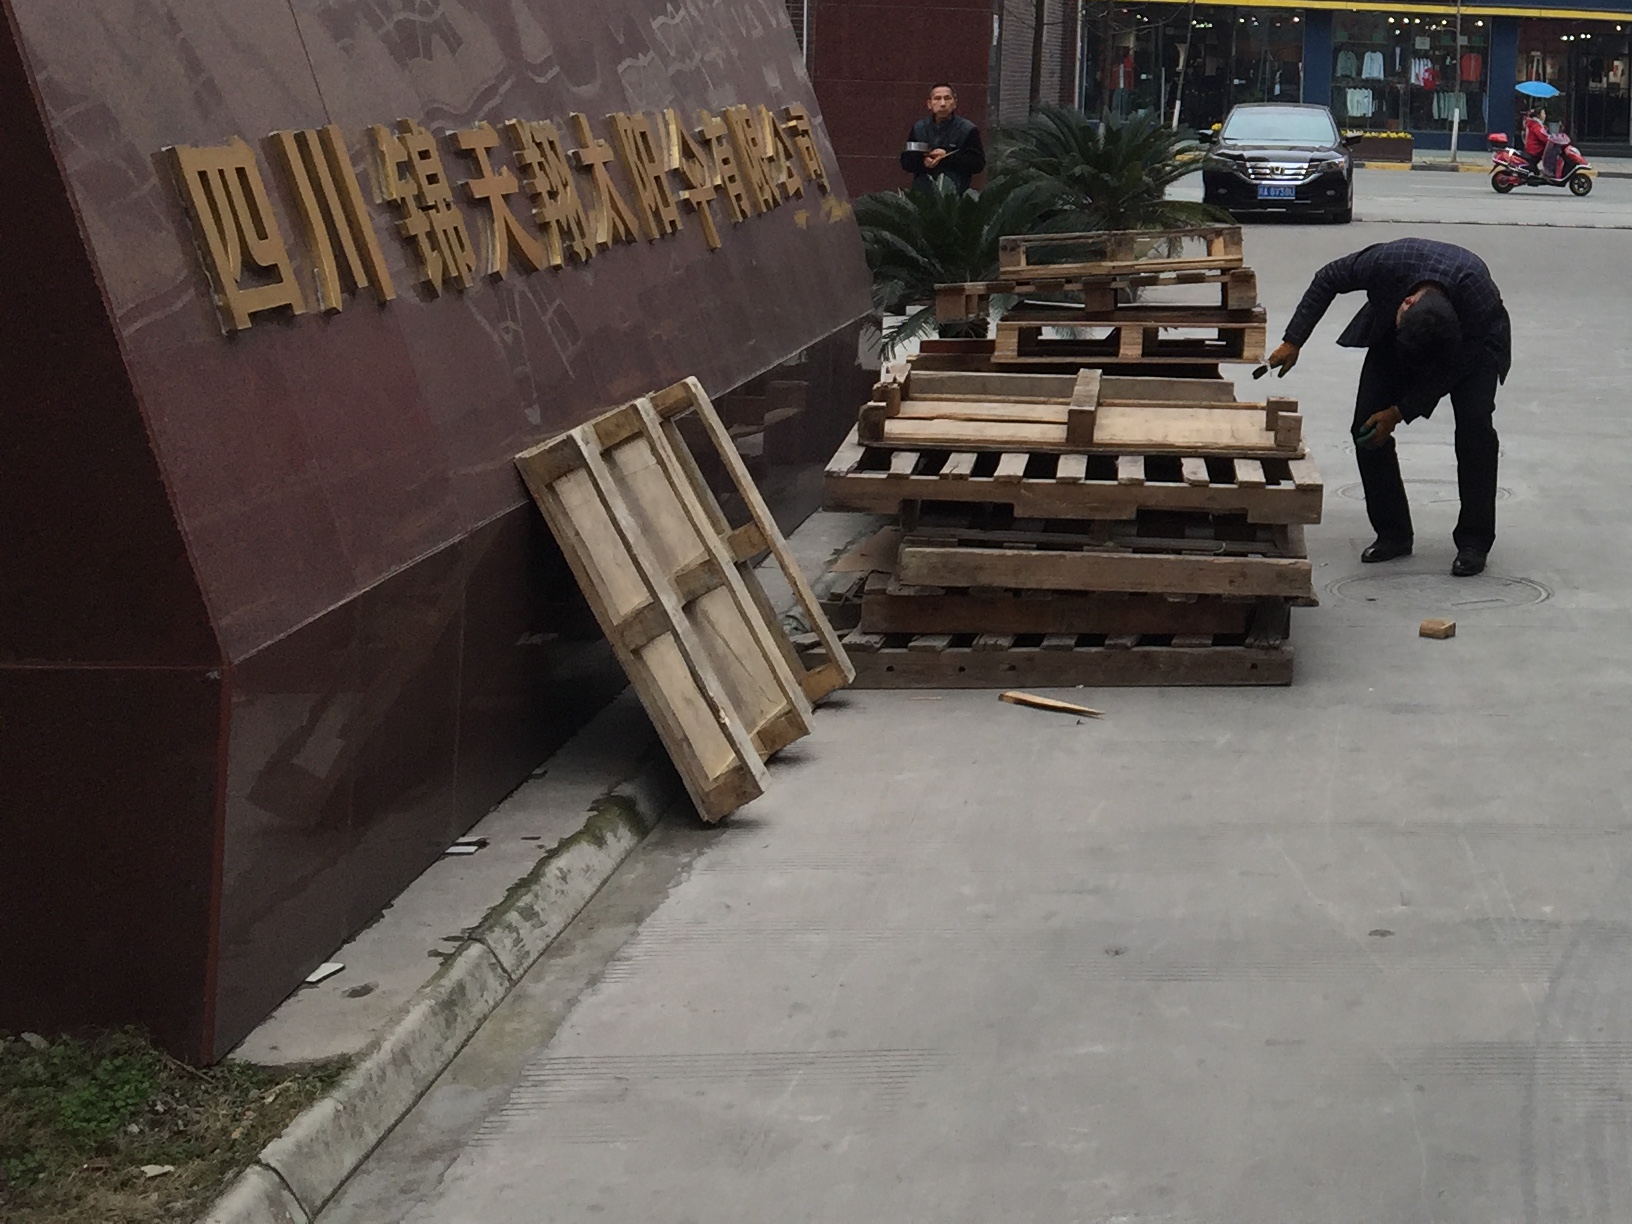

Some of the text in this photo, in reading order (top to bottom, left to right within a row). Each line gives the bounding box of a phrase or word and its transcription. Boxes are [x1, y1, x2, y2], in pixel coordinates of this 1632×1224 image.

[153, 102, 831, 333] 四川锦天翔太阳伞有限公司
